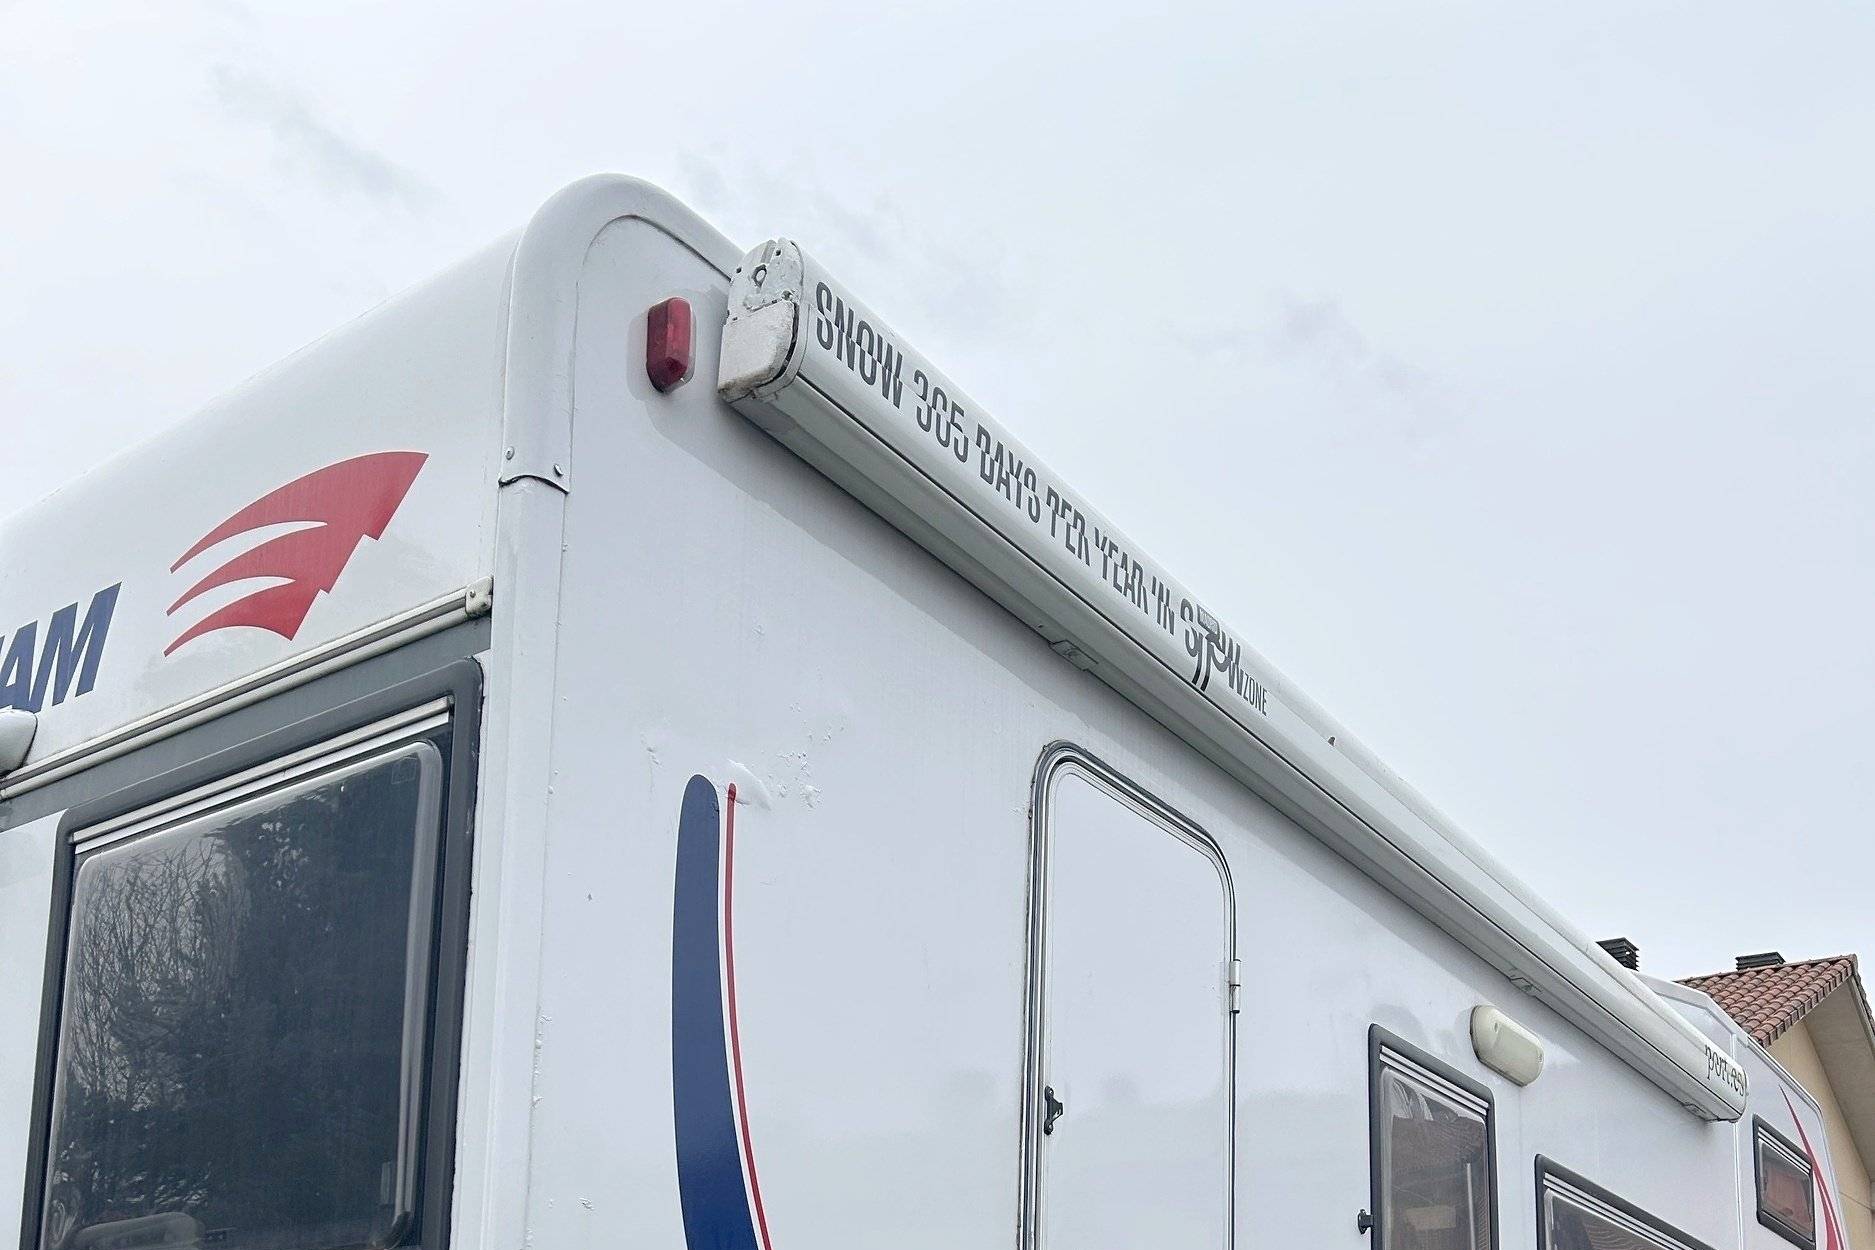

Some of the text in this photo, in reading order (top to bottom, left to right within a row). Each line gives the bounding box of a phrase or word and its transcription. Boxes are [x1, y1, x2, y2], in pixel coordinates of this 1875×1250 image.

[816, 282, 904, 410] SNOW
[976, 423, 1042, 524] DAYS
[1046, 485, 1091, 567] PER
[1094, 527, 1149, 616] YEAR
[1152, 576, 1175, 636] IN
[0, 581, 122, 715] AM
